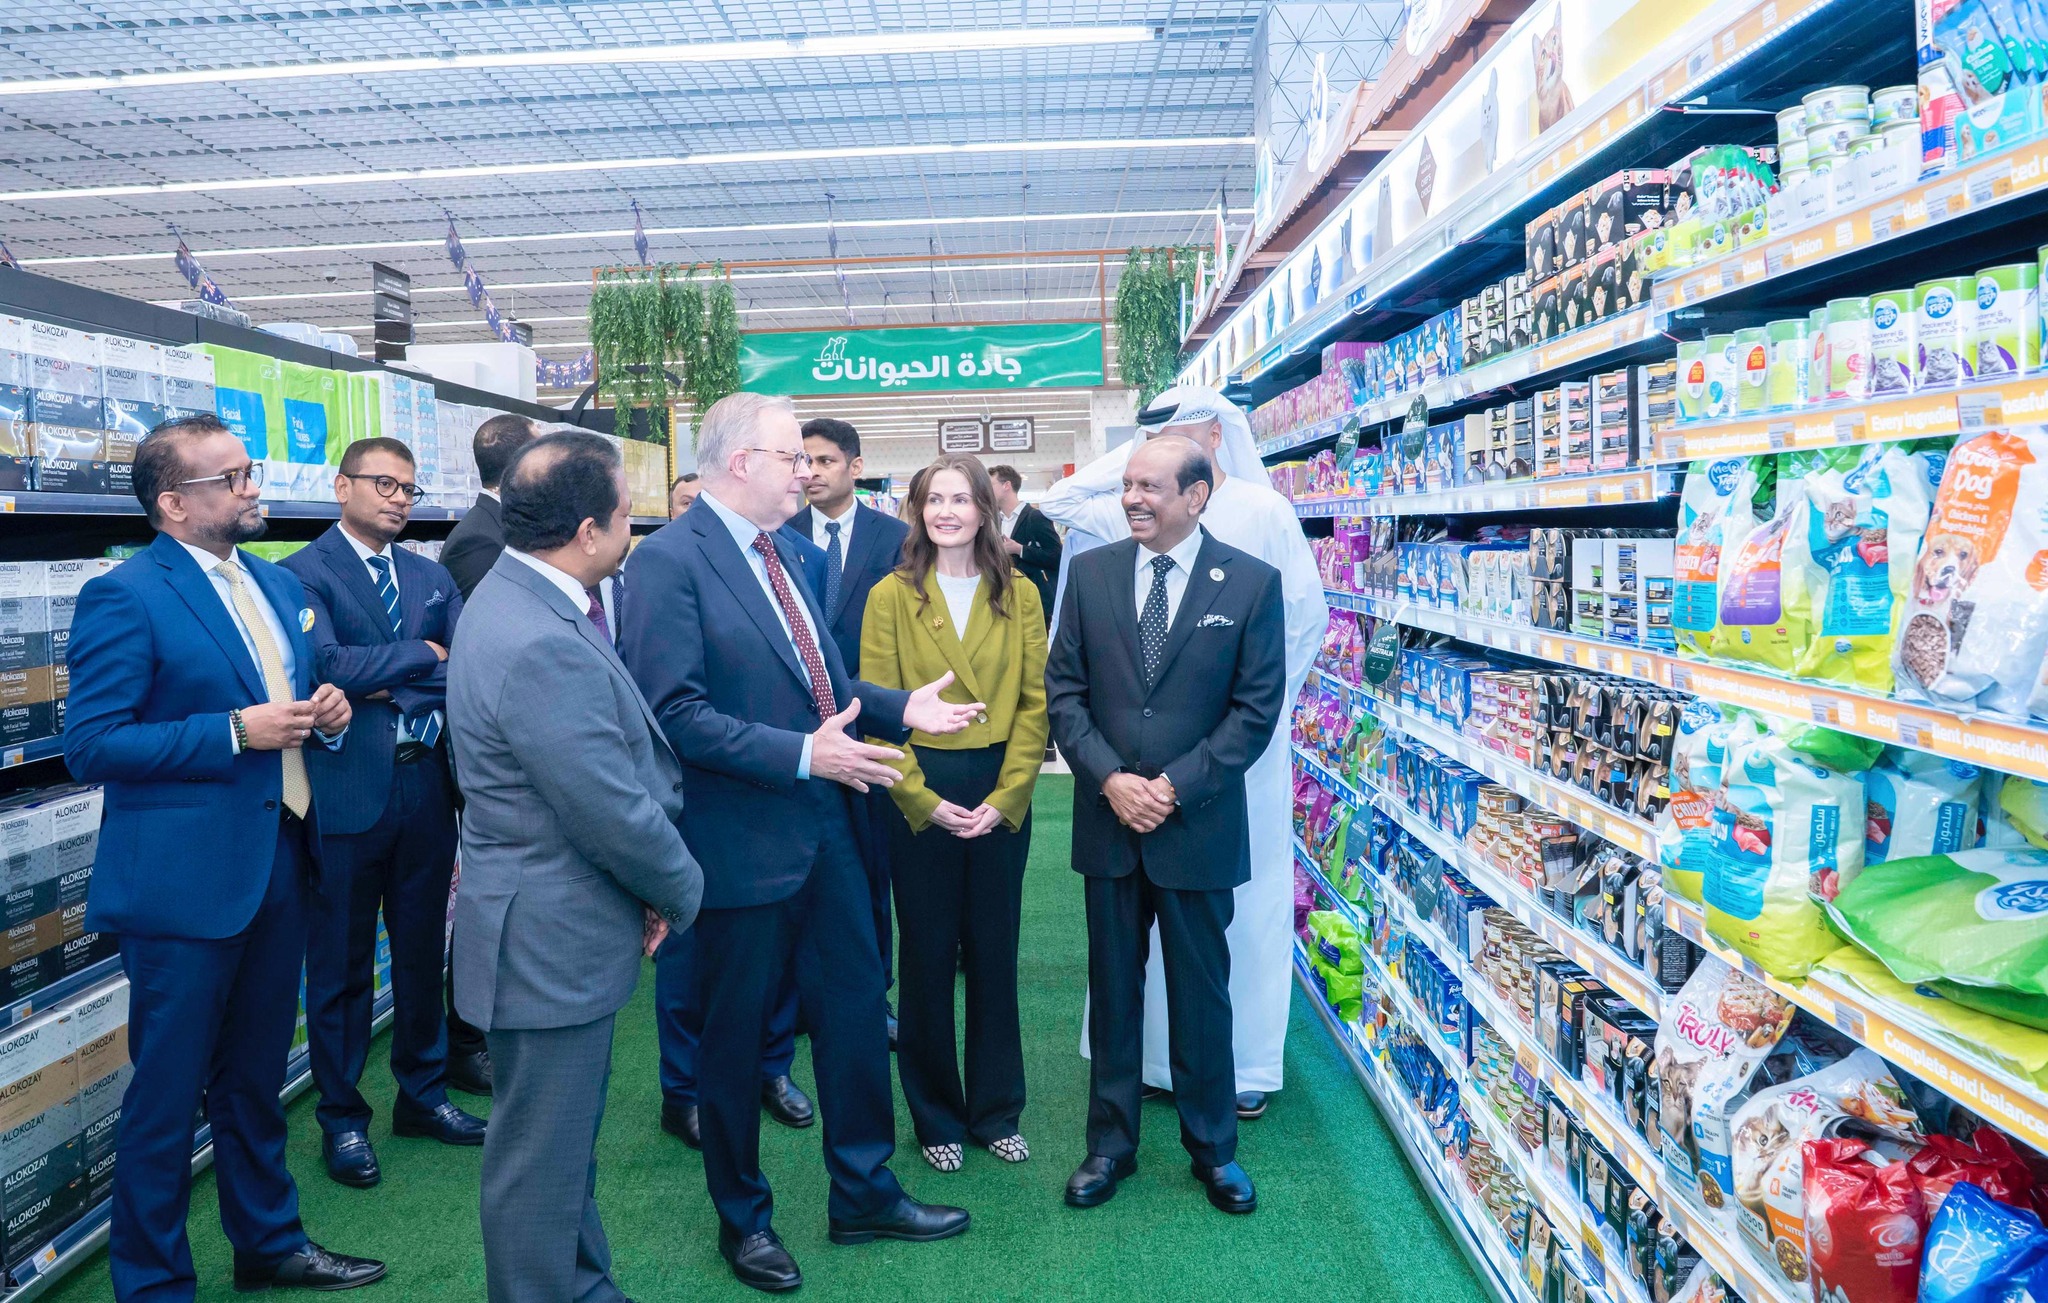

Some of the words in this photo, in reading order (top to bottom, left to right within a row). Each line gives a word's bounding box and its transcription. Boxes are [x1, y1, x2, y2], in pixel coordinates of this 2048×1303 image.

[1792, 235, 1823, 259] trition
[32, 323, 69, 338] ALOKOZAY
[165, 348, 193, 360] ALOKOZAY
[34, 357, 71, 371] ALOKOZAY
[812, 355, 950, 387] الحيوانات
[957, 352, 1022, 382] جادة
[106, 369, 138, 380] ALOKOZAY
[36, 391, 73, 404] ALOKOZAY
[40, 423, 76, 438] ALOKOZAY
[1795, 424, 1835, 440] selected
[1871, 414, 1904, 437] Every
[108, 431, 139, 442] ALOKOZAY
[42, 459, 78, 471] ALOKOZAY
[1954, 469, 1993, 499] Dog
[1948, 508, 1979, 523] Chicken
[1980, 512, 1988, 525] &
[1941, 519, 1987, 535] Vegetables
[49, 562, 84, 573] ALOKOZAY
[1370, 646, 1394, 657] AUSTRALIA
[0, 672, 27, 682] Alokozay
[2, 707, 29, 718] Alokozay
[1867, 708, 1898, 733] Every
[55, 801, 91, 819] ALOKOZAY
[1, 819, 29, 831] Alokozay
[1813, 808, 1825, 848] سلمون
[1938, 805, 1952, 845] سلمون
[57, 834, 93, 852] ALOKOZAY
[6, 888, 34, 903] Alokozay
[8, 923, 36, 939] Alokozay
[64, 932, 100, 953] ALOKOZAY
[10, 958, 39, 974] Alokozay
[78, 993, 114, 1018] ALOKOZAY
[1677, 1004, 1735, 1058] TRULY
[81, 1032, 117, 1058] ALOKOZAY
[1882, 1029, 1949, 1080] Complete
[1950, 1068, 1978, 1100] and
[0, 1072, 42, 1100] ALOKOZAY
[84, 1070, 119, 1098] ALOKOZAY
[1518, 1072, 1530, 1089] 34.20
[2, 1113, 46, 1145] ALOKOZAY
[86, 1109, 122, 1139] ALOKOZAY
[4, 1154, 49, 1189] ALOKOZAY
[89, 1152, 117, 1178] ALOKOZ
[7, 1195, 52, 1231] ALOKOZAY
[1743, 1209, 1764, 1233] FOOD
[1784, 1223, 1805, 1239] KITTE
